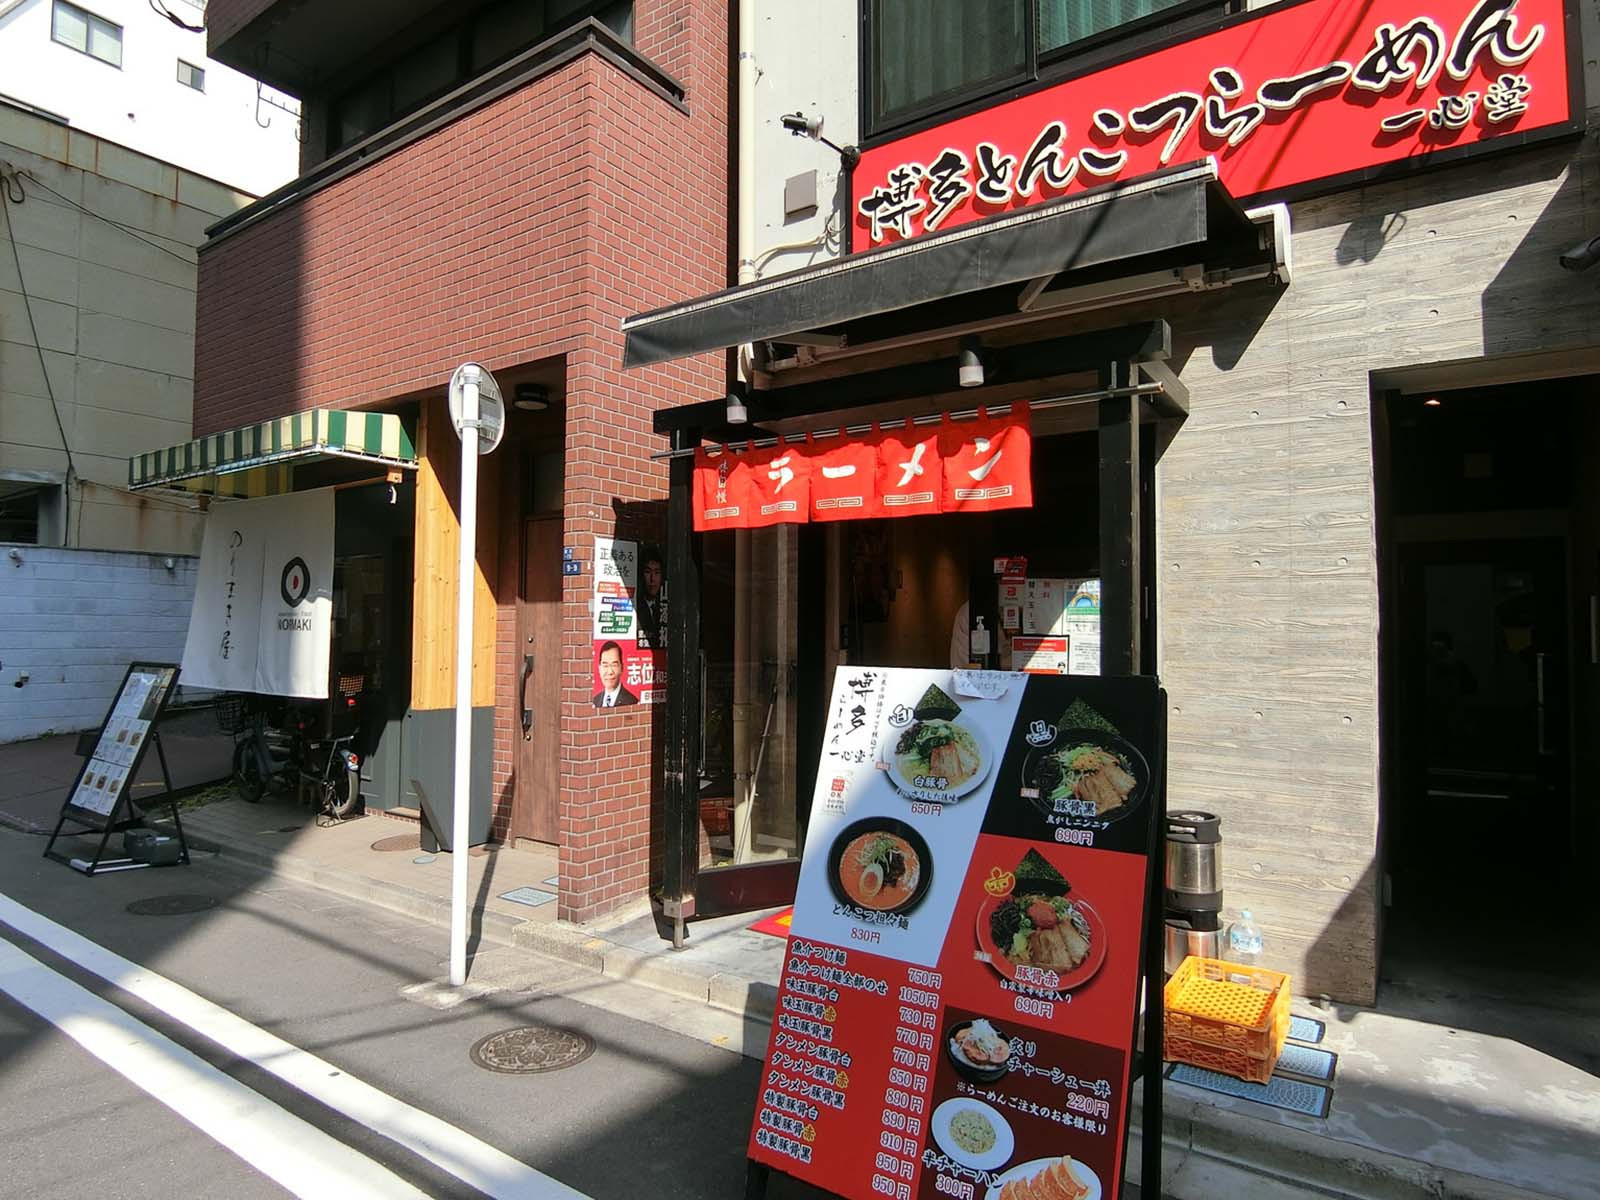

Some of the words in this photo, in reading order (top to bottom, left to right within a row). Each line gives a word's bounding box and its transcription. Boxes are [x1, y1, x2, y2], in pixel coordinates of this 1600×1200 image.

[859, 0, 1547, 242] 博多とんこつらーめん
[1380, 74, 1532, 132] 一心堂
[768, 437, 1002, 494] ラーメン
[847, 672, 877, 735] 博多
[913, 775, 949, 791] 白豚骨
[1053, 799, 1096, 817] 豚骨黒
[911, 802, 942, 817] 650円
[1055, 828, 1094, 846] 690円
[832, 903, 910, 930] とんこつ担々麺
[851, 927, 881, 944] 830円
[788, 958, 888, 995] 魚介つけ麺全部のせ
[899, 987, 939, 1008] 1050円
[791, 940, 846, 965] 魚介つけ麺
[908, 968, 941, 988] 750円
[1015, 964, 1059, 987] 豚骨赤
[782, 995, 837, 1022] 味玉豚骨赤
[896, 1027, 933, 1050] 770円
[785, 976, 839, 1002] 味玉豚骨白
[899, 1007, 936, 1030] 730円
[1015, 995, 1053, 1019] 690円
[775, 1031, 851, 1067] タンメン豚骨白
[889, 1068, 927, 1092] 850円
[779, 1014, 833, 1041] 味玉豚骨黒
[893, 1047, 930, 1071] 770円
[1009, 1037, 1036, 1057] 炙り
[771, 1051, 849, 1088] タンメン豚骨赤
[885, 1089, 923, 1114] 890円
[1007, 1056, 1111, 1098] チャーシュー丼
[763, 1089, 819, 1120] 特製豚骨白
[880, 1132, 917, 1156] 910円
[767, 1071, 845, 1109] タンメン豚骨黒
[882, 1110, 921, 1135] 890円
[1066, 1092, 1109, 1119] 220円
[756, 1129, 812, 1163] 特製豚骨黒
[872, 1175, 910, 1200] 950円
[760, 1109, 816, 1142] 特製豚骨赤
[875, 1153, 914, 1179] 950円
[936, 1174, 974, 1200] 300円
